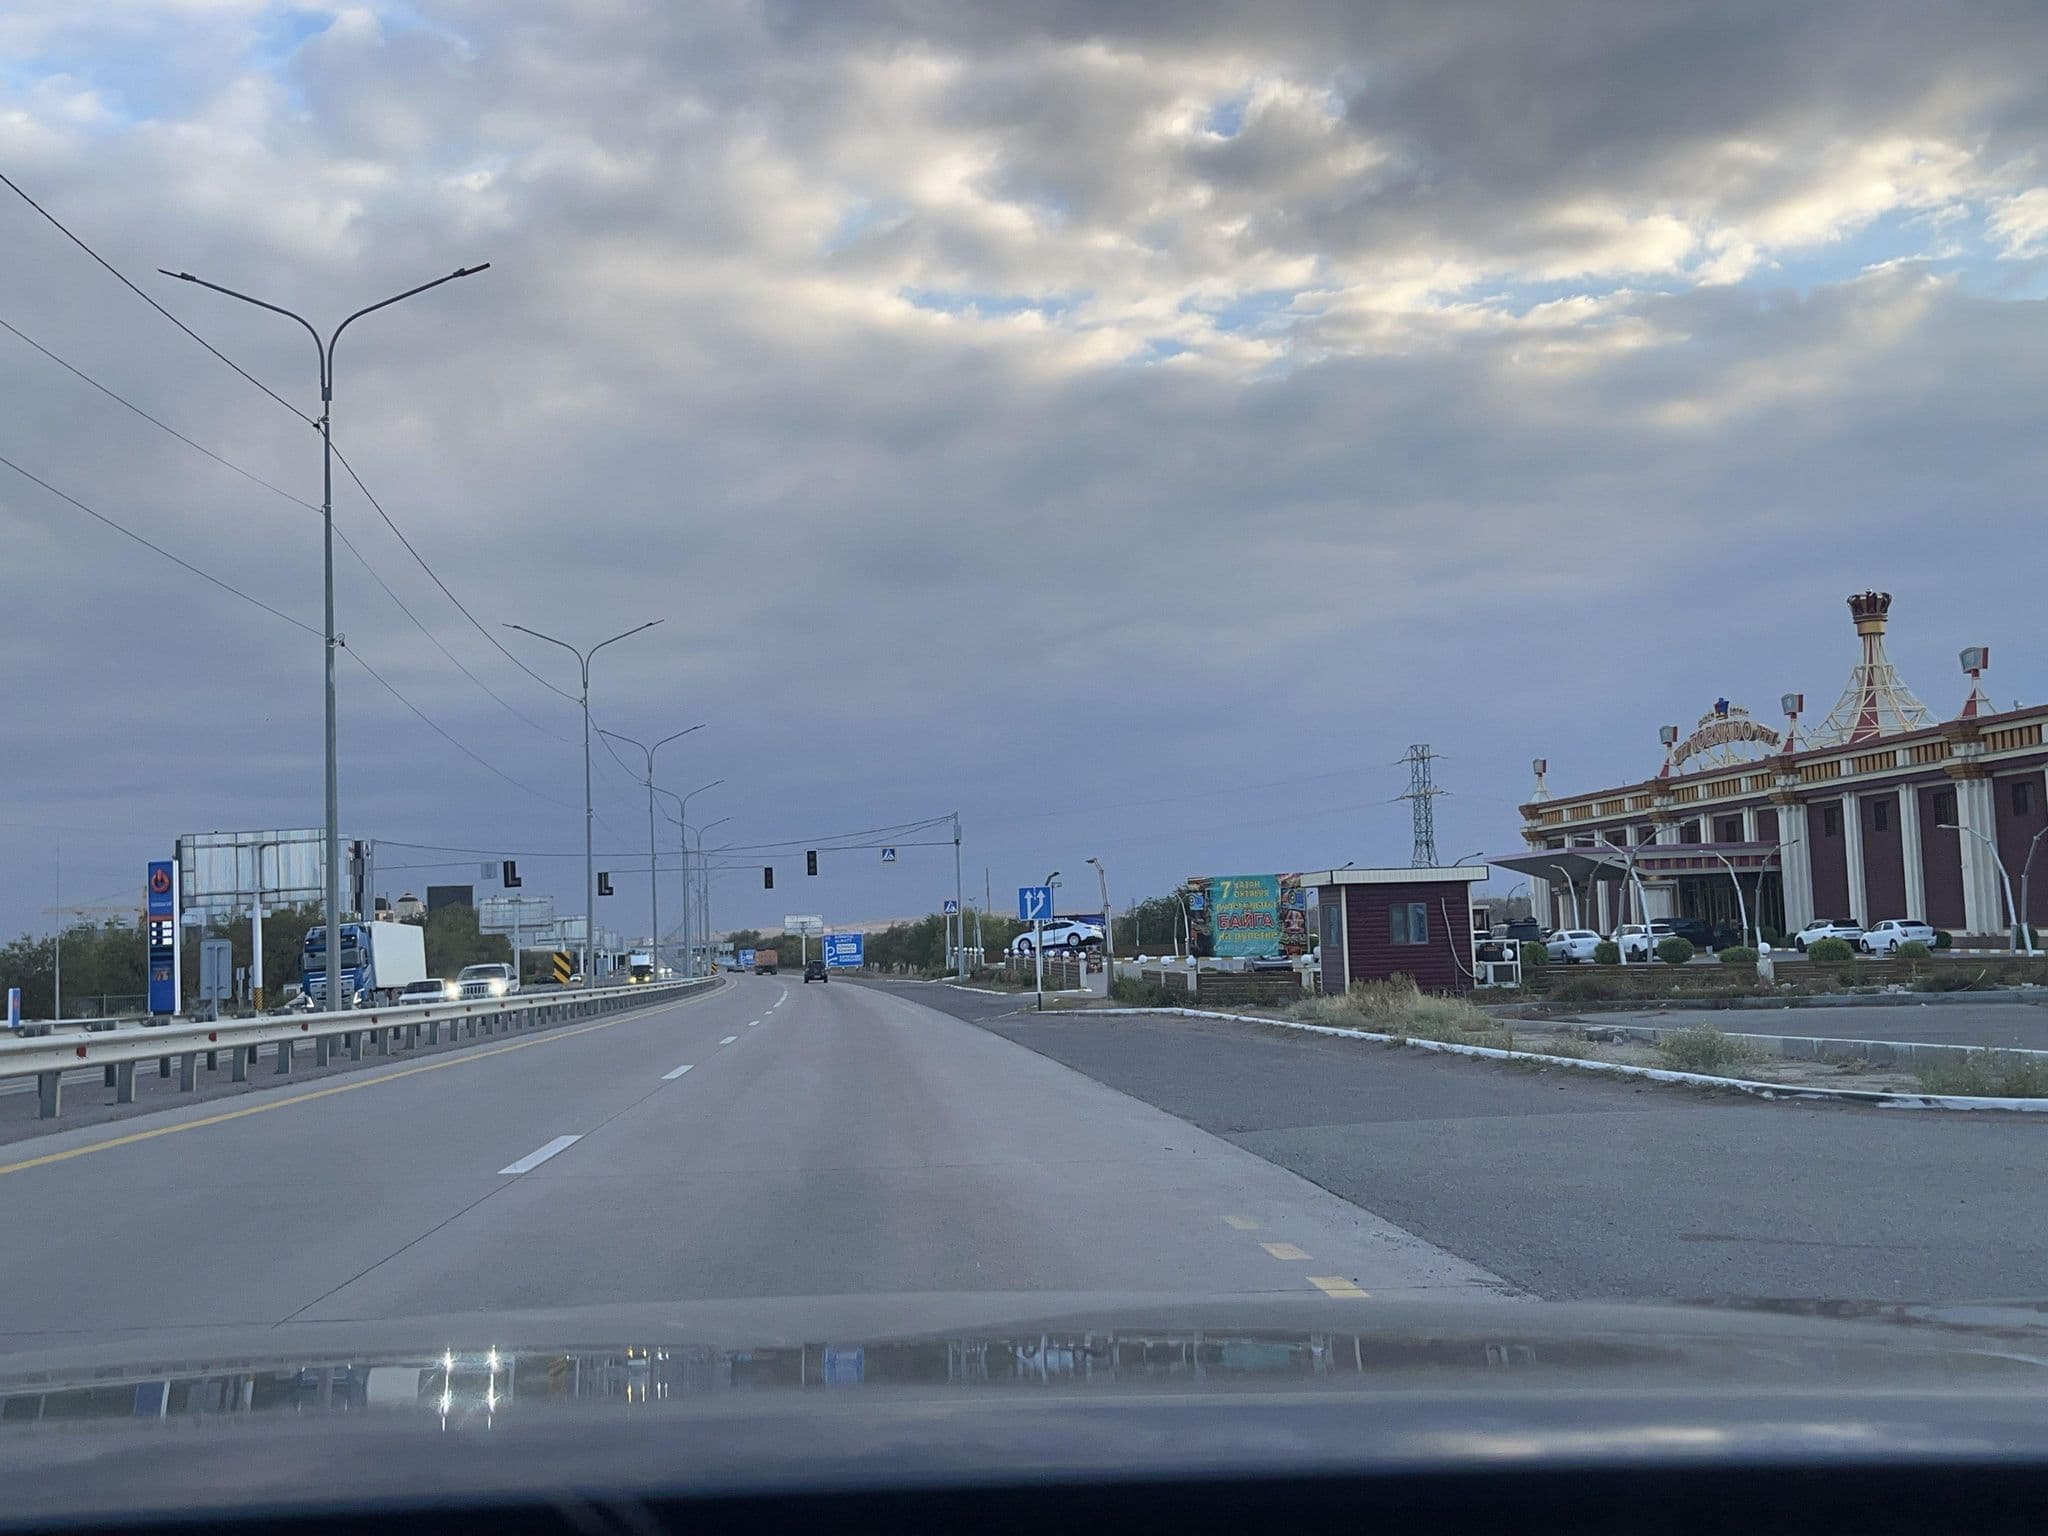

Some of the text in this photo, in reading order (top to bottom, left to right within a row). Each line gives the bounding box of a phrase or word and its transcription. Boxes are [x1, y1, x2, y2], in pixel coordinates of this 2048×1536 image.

[1690, 721, 1752, 754] TORNADO
[1221, 880, 1231, 898] 7
[1218, 909, 1274, 930] БАЙГА
